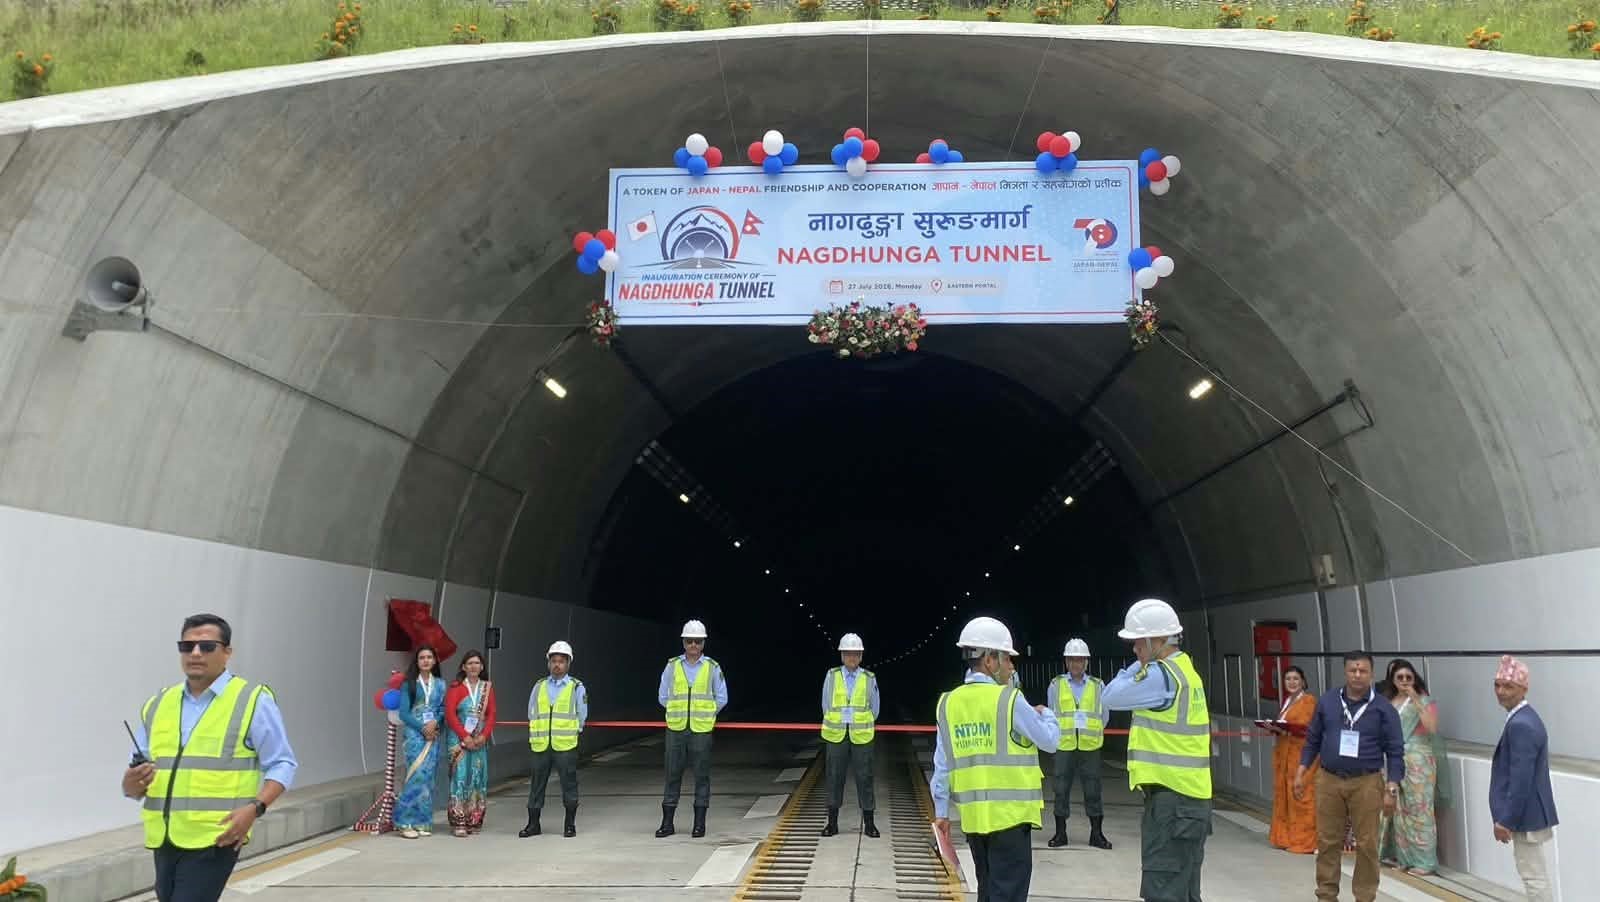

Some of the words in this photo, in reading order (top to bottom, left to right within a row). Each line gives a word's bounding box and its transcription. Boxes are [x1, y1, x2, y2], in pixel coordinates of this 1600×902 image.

[623, 187, 632, 196] A
[634, 187, 667, 196] TOKEN
[670, 187, 684, 196] OF
[687, 186, 720, 195] JAPAN
[729, 185, 761, 195] NEPAL
[764, 184, 825, 193] FRIENDSHIP
[827, 183, 850, 192] AND
[852, 183, 926, 192] COOPERATION
[932, 181, 960, 191] जापान
[969, 180, 997, 191] नेपाल
[1000, 180, 1028, 191] मित्रता
[1032, 181, 1039, 190] र
[1094, 178, 1122, 189] प्रतीक
[808, 213, 904, 239] नागढुङ्गा
[777, 246, 940, 264] NAGDHUNGA
[949, 244, 1051, 263] TUNNEL
[641, 273, 702, 281] INAUGURATION
[704, 272, 747, 280] CEREMONY
[749, 272, 760, 280] OF
[618, 282, 714, 300] NAGDHUNGA
[719, 281, 775, 299] TUNNEL
[859, 283, 873, 291] July
[895, 282, 922, 290] Monday
